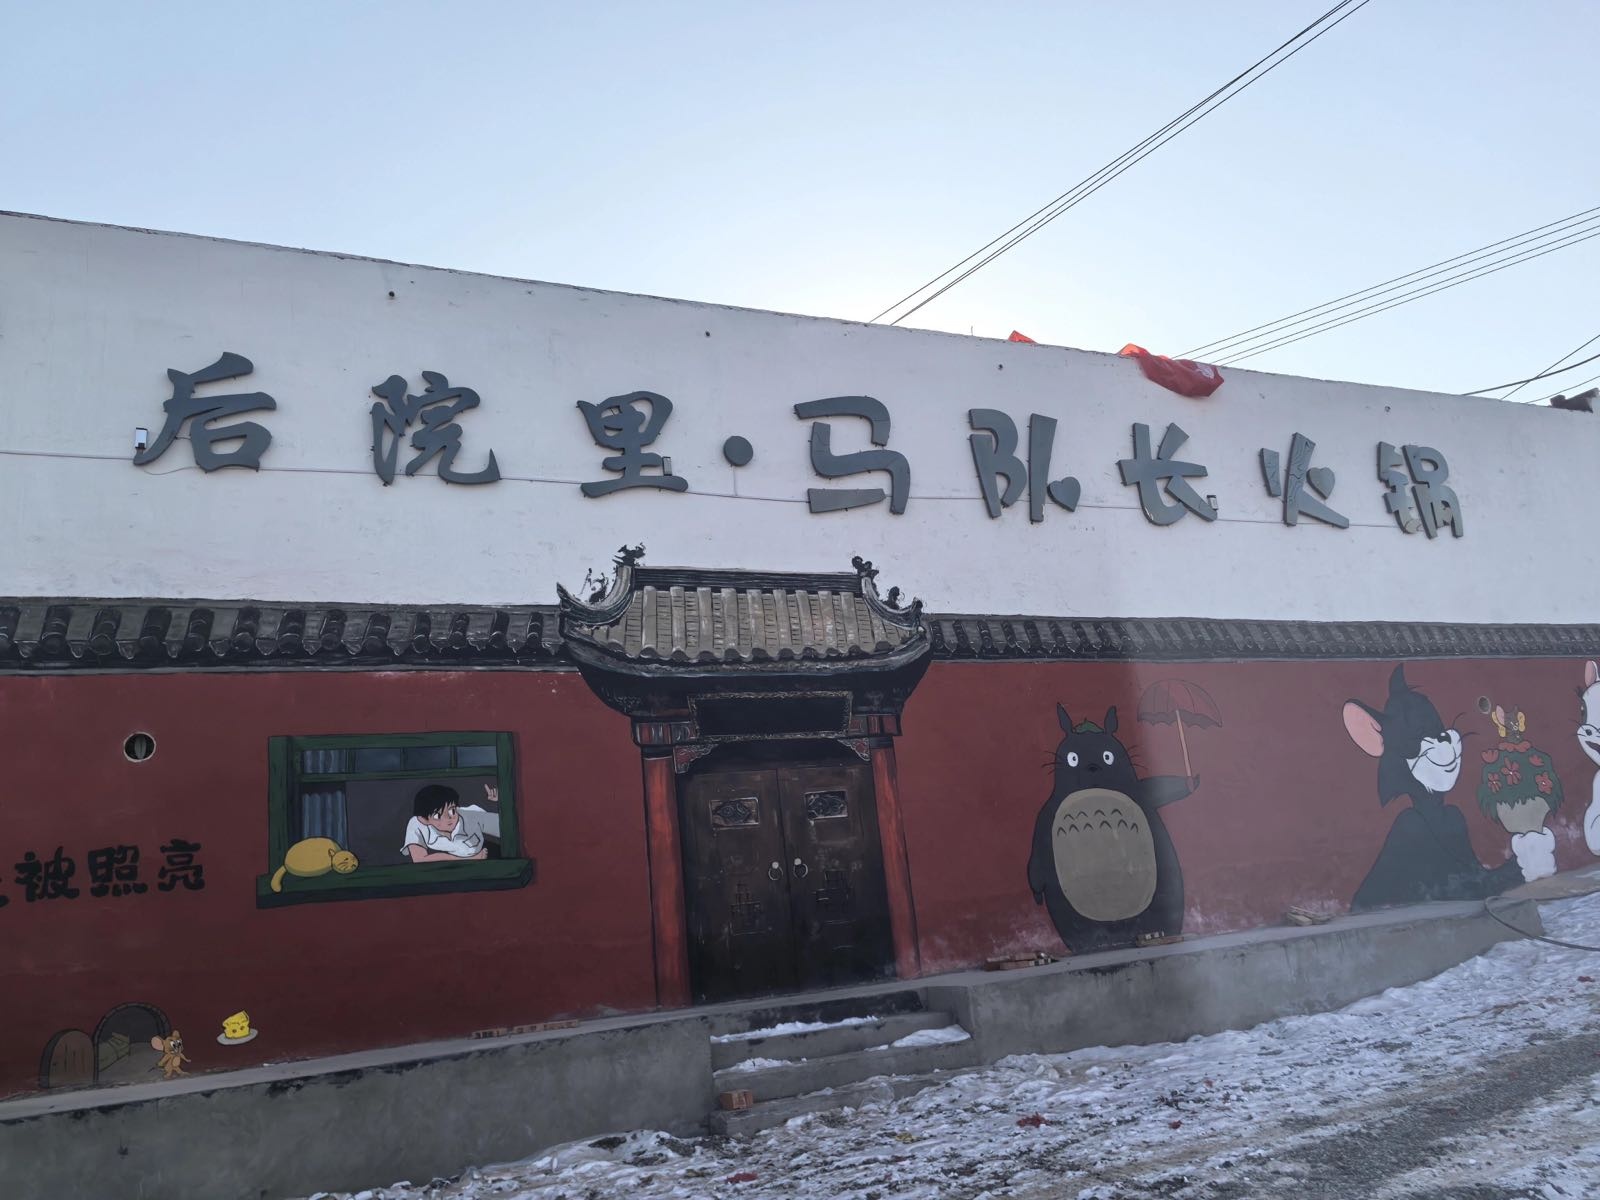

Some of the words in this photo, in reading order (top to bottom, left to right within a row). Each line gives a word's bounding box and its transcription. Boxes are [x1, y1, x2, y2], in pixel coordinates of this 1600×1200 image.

[134, 352, 1464, 538] 后院里·马队长火锅
[0, 839, 205, 907] 被照亮
